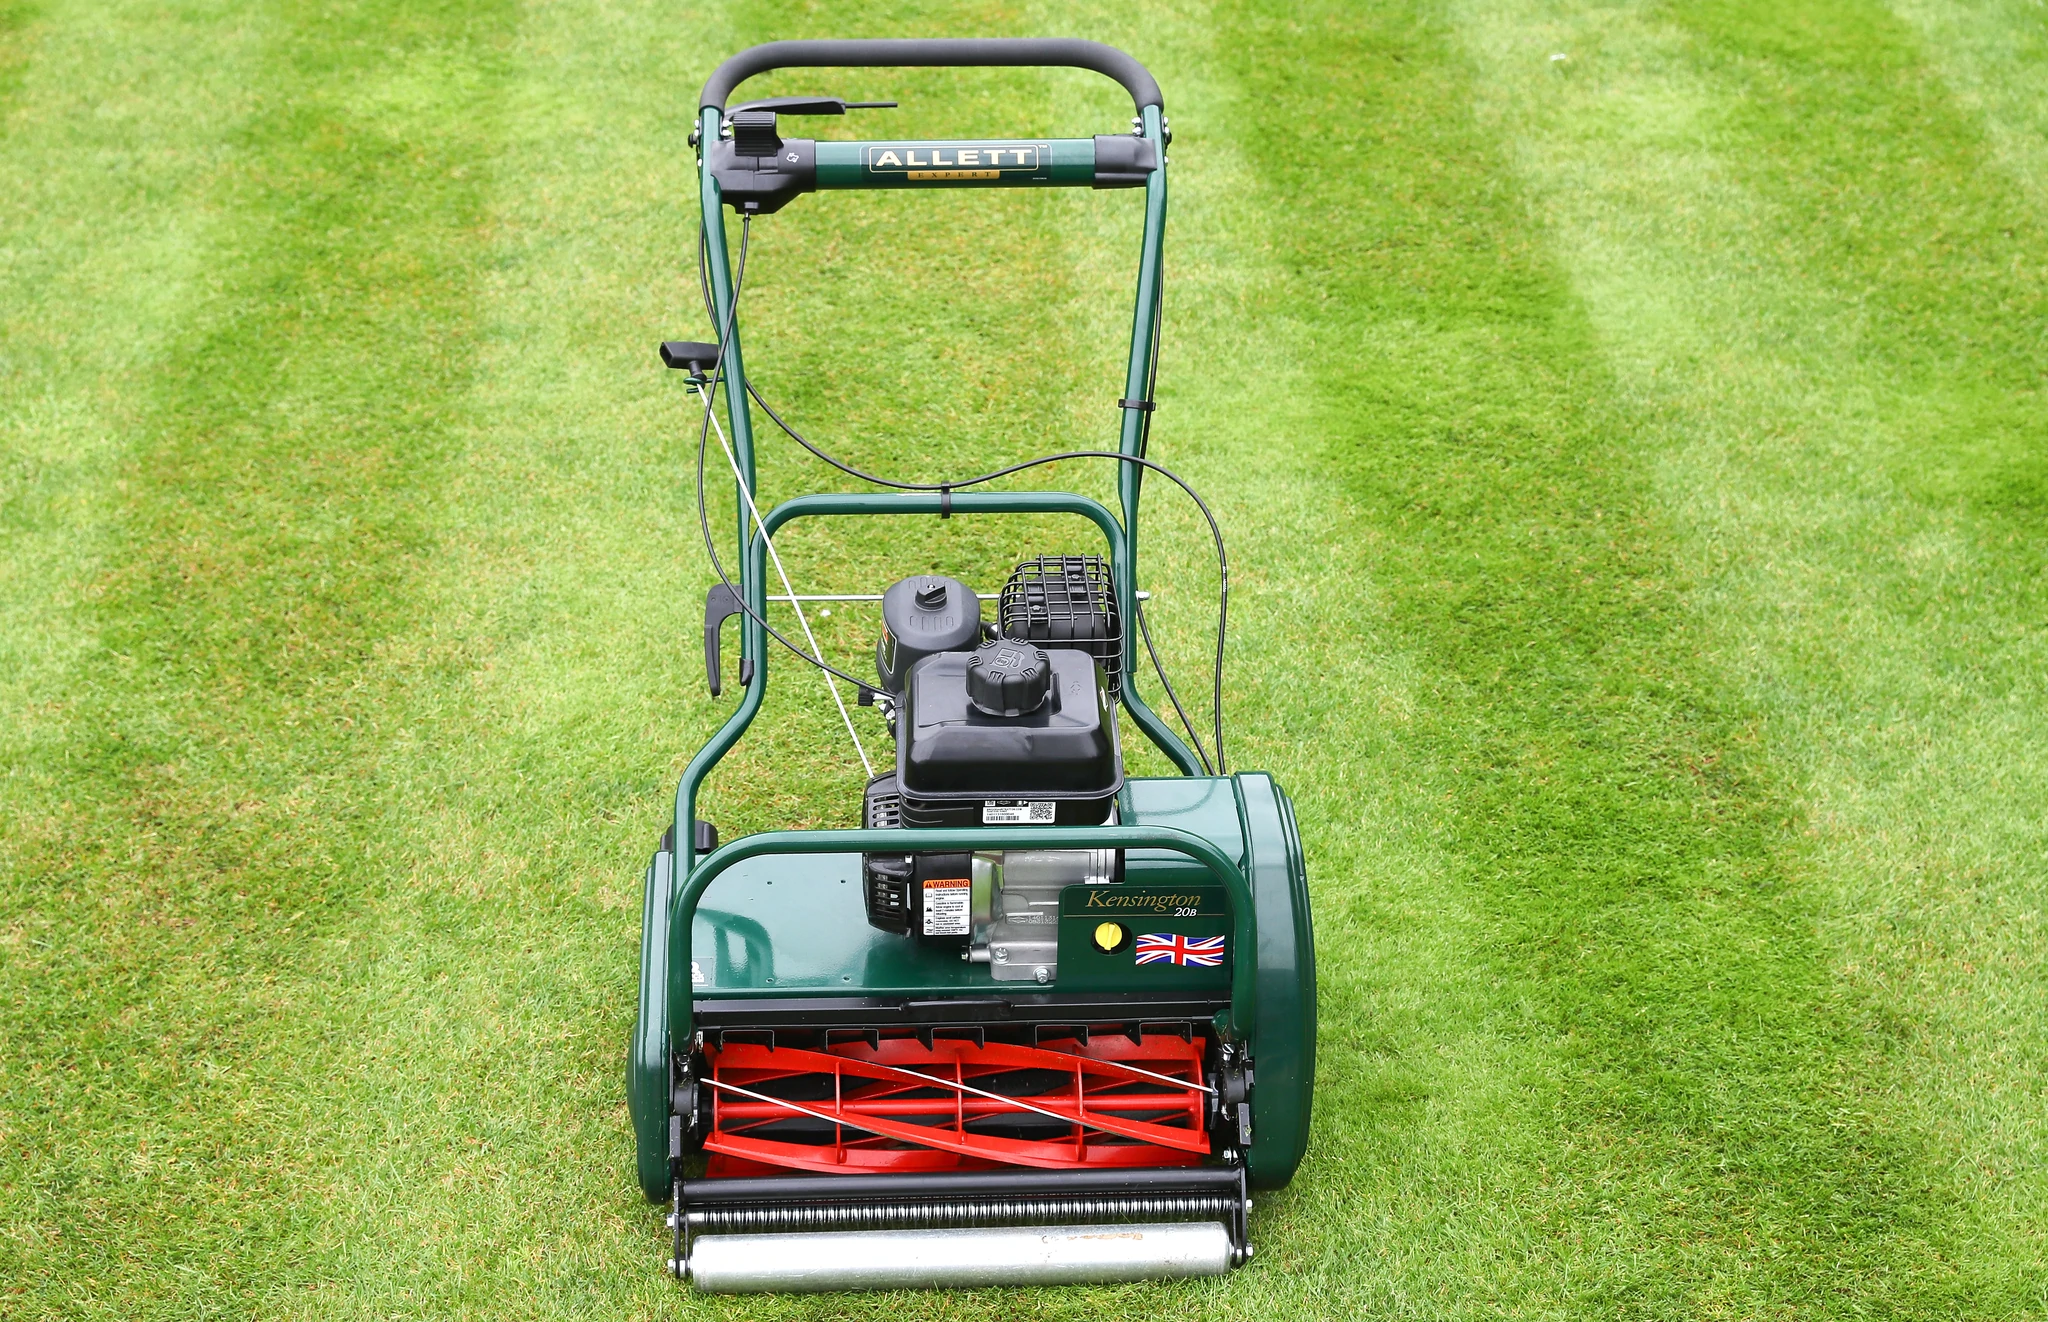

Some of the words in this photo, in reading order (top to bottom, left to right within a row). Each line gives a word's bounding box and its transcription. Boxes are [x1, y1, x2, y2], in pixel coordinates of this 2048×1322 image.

[876, 149, 1033, 167] ALLETT
[932, 880, 969, 888] WARNING
[1085, 889, 1201, 912] Kensington
[1173, 907, 1197, 918] 20B
